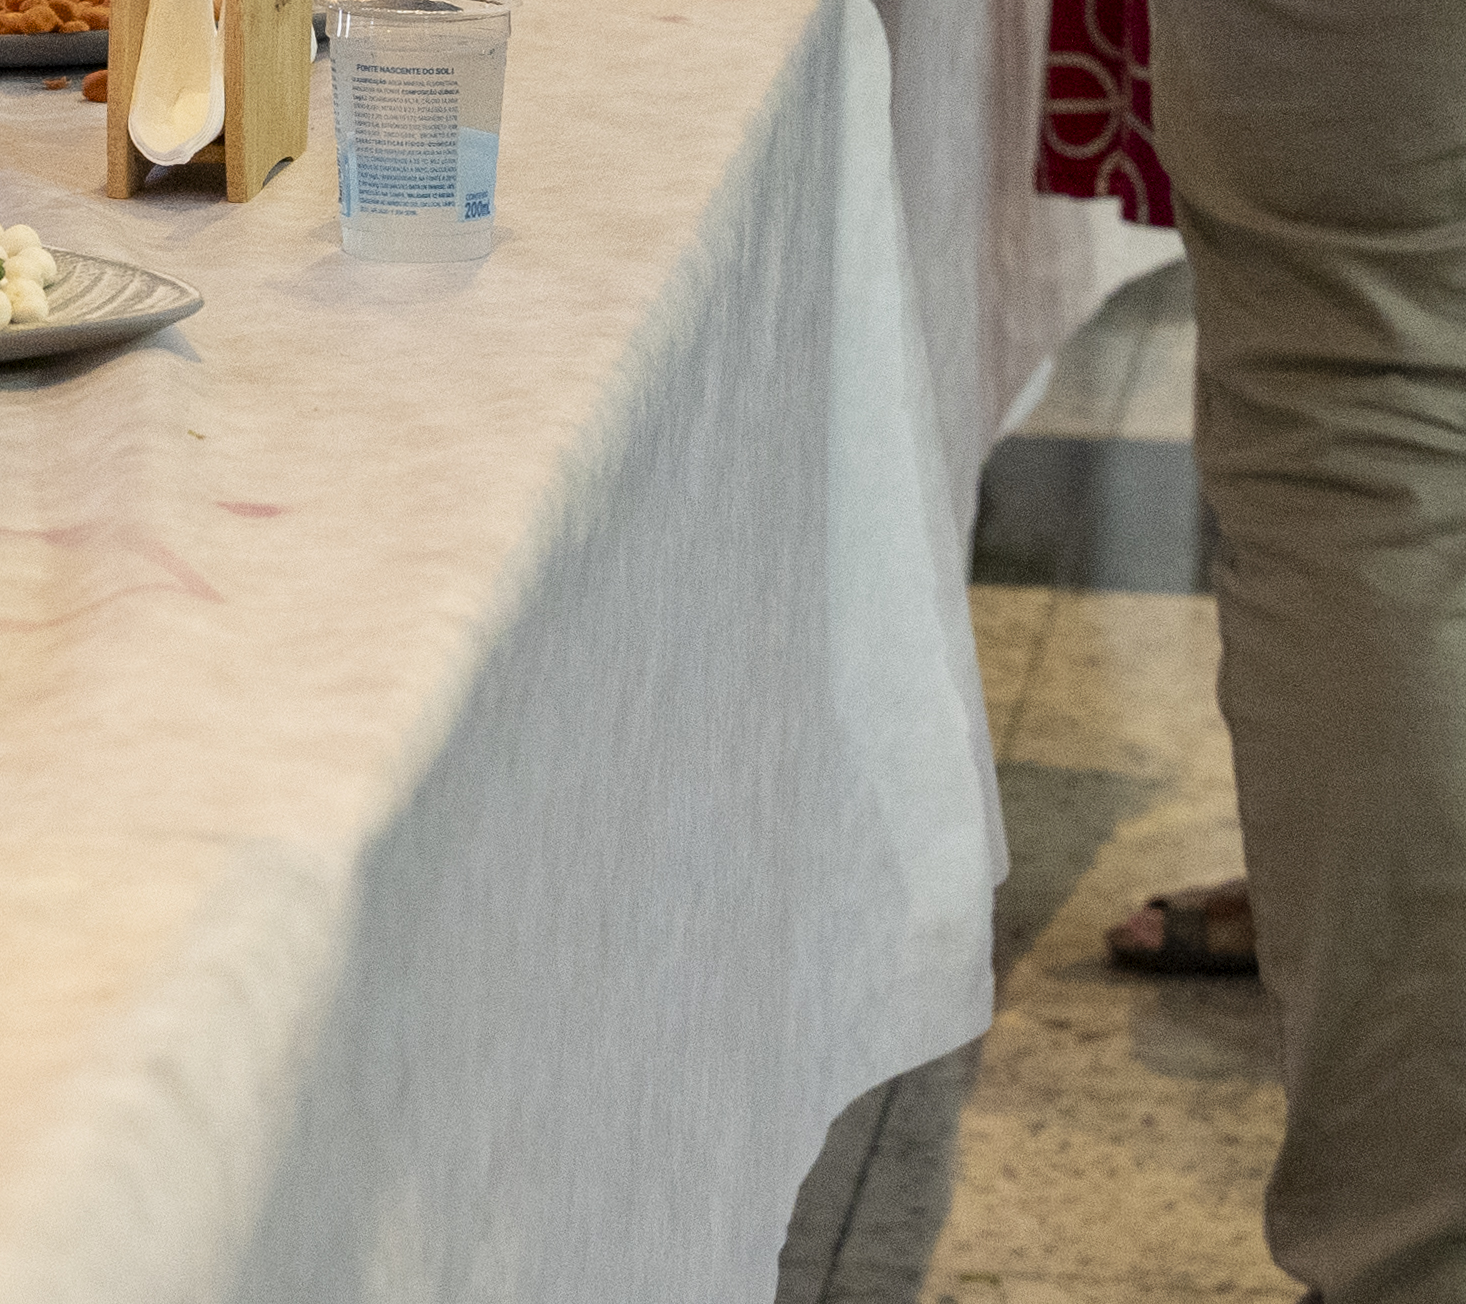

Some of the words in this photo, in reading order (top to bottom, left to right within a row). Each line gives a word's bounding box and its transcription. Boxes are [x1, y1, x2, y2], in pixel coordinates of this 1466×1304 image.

[356, 63, 378, 73] FONTE
[379, 66, 421, 75] NASCENTE
[422, 67, 435, 75] DO
[435, 67, 450, 75] SOL
